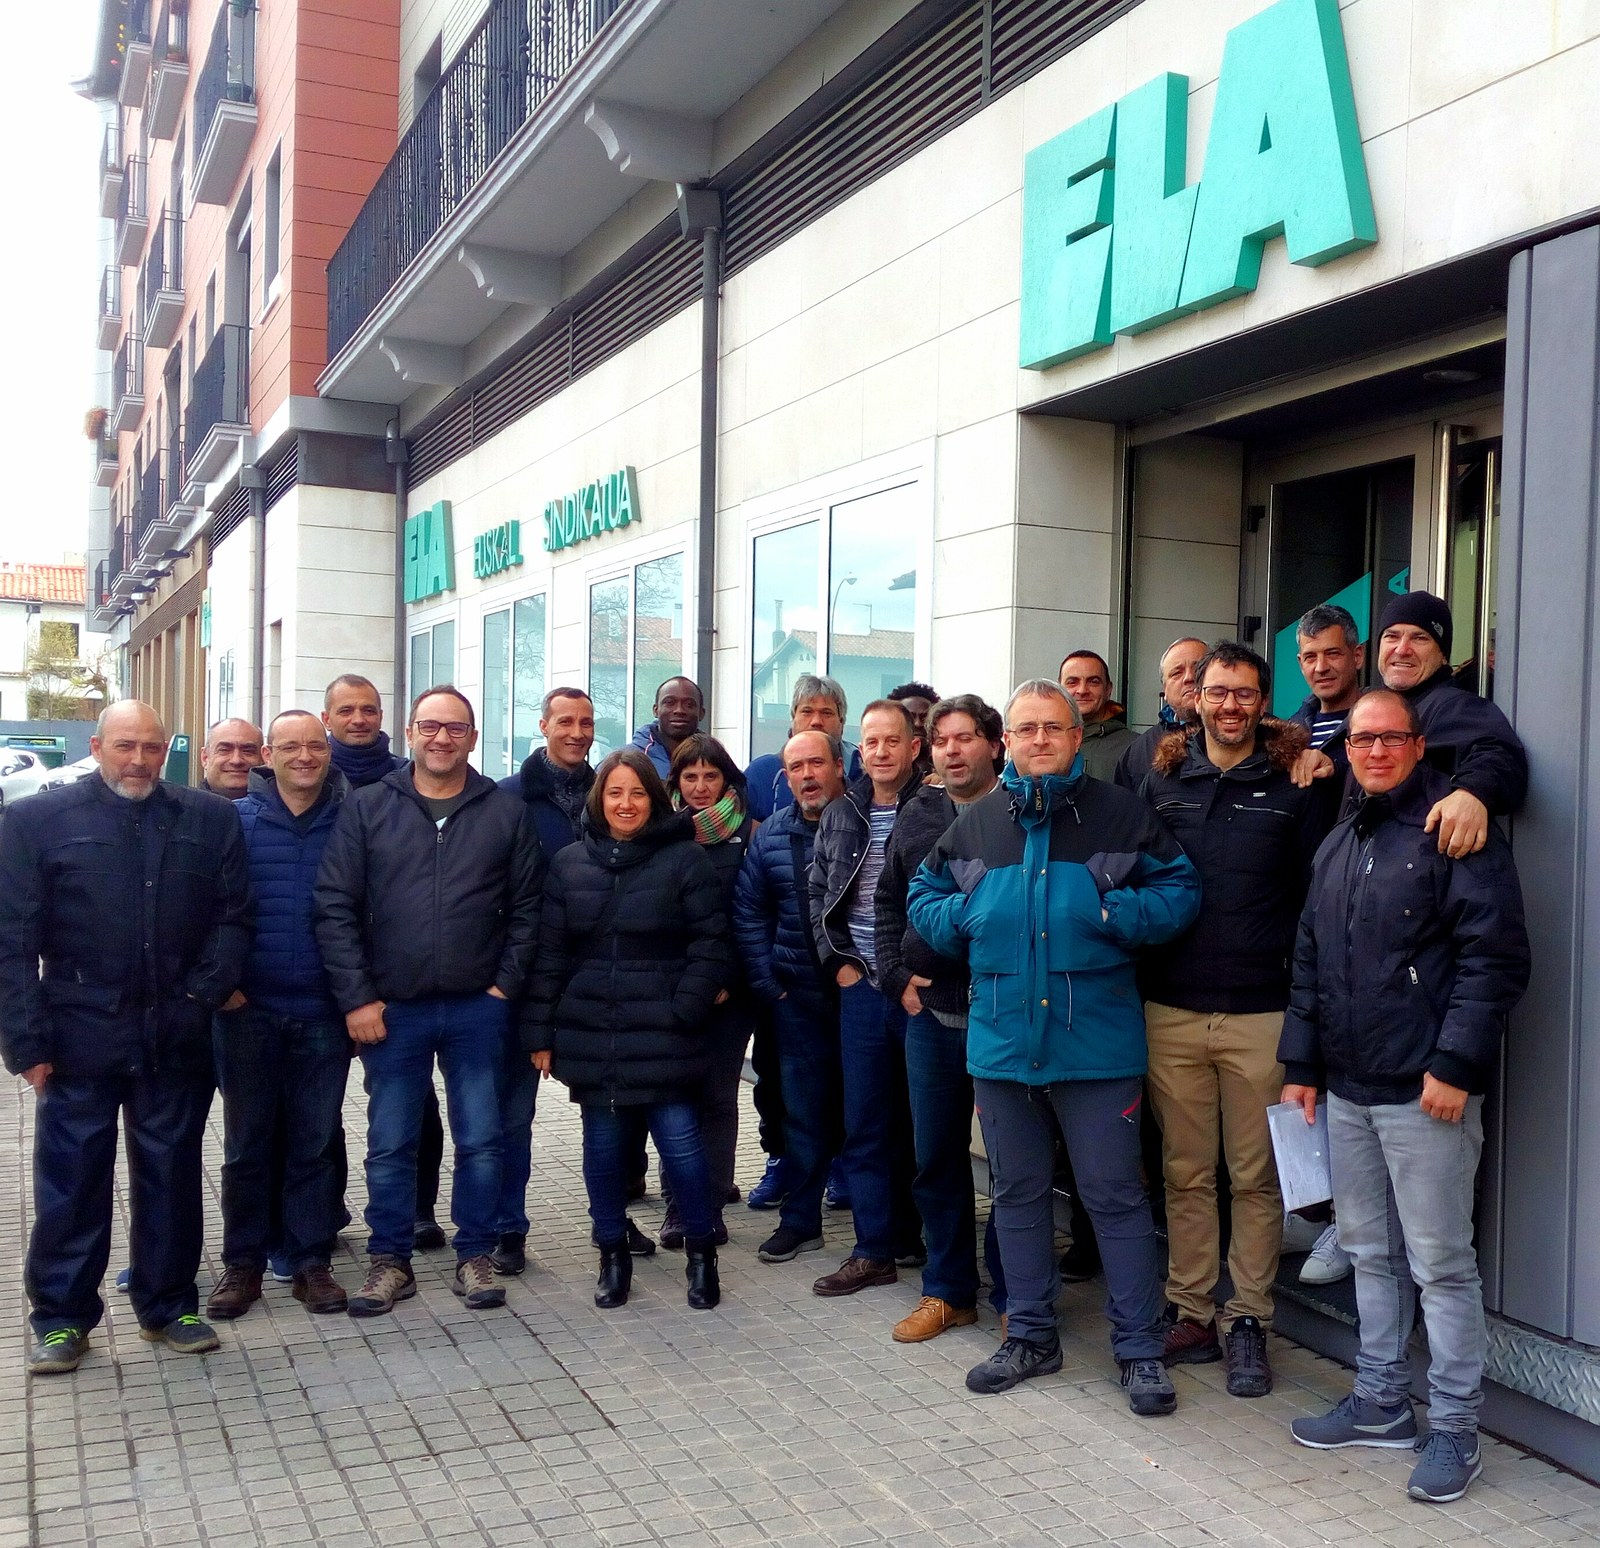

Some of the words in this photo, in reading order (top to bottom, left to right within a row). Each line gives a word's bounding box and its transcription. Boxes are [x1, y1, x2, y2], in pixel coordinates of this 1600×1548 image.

[1020, 0, 1378, 371] ELA
[404, 500, 456, 604] ELA
[474, 520, 524, 579] EUSKAL
[542, 465, 641, 553] SINDIKATUA
[176, 737, 188, 751] P
